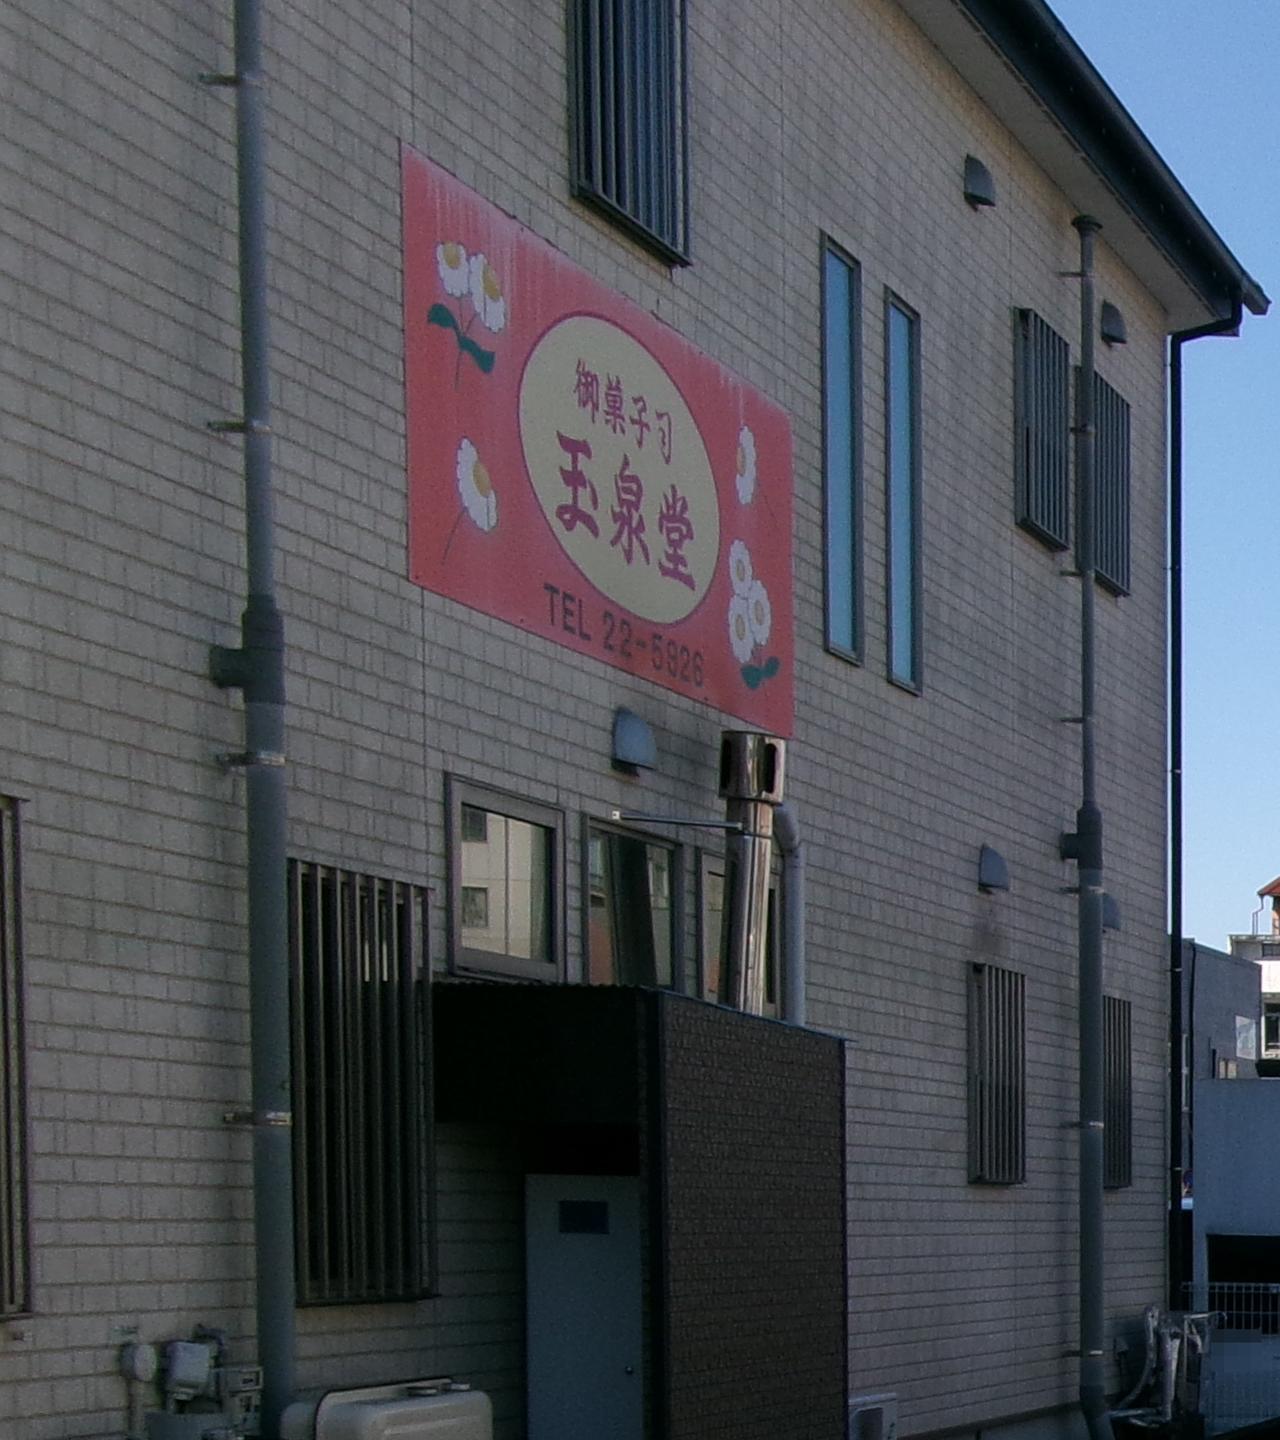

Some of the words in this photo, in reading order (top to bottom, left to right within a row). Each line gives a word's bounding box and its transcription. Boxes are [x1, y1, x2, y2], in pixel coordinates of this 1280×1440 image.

[556, 430, 695, 591] 玉泉堂
[544, 583, 591, 641] TEL
